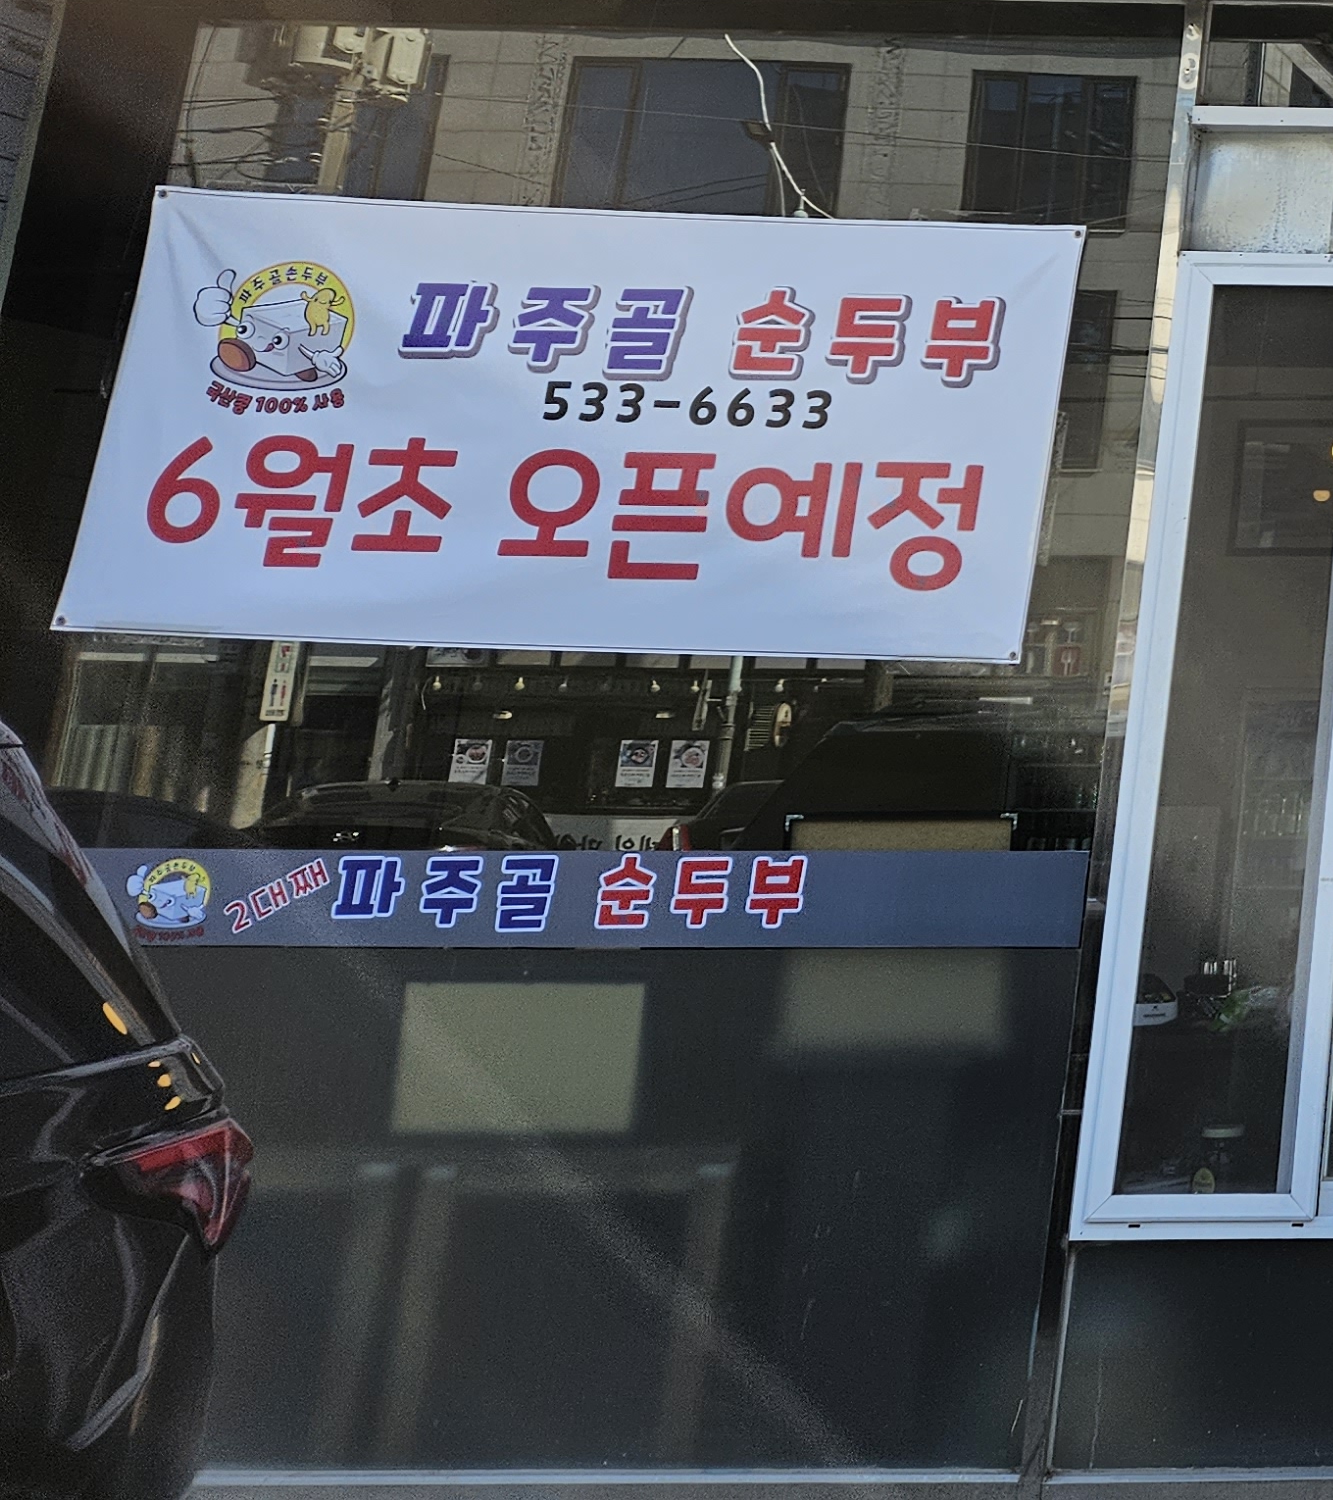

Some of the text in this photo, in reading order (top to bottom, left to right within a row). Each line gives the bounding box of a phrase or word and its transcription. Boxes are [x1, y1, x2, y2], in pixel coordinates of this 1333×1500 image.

[399, 279, 1005, 386] 파주골 순두부
[255, 396, 308, 414] 100%
[312, 388, 345, 411] 사용
[542, 380, 833, 430] 533-6633
[145, 435, 459, 569] 6월초
[331, 854, 559, 932] 파주골
[595, 854, 808, 929] 순두부
